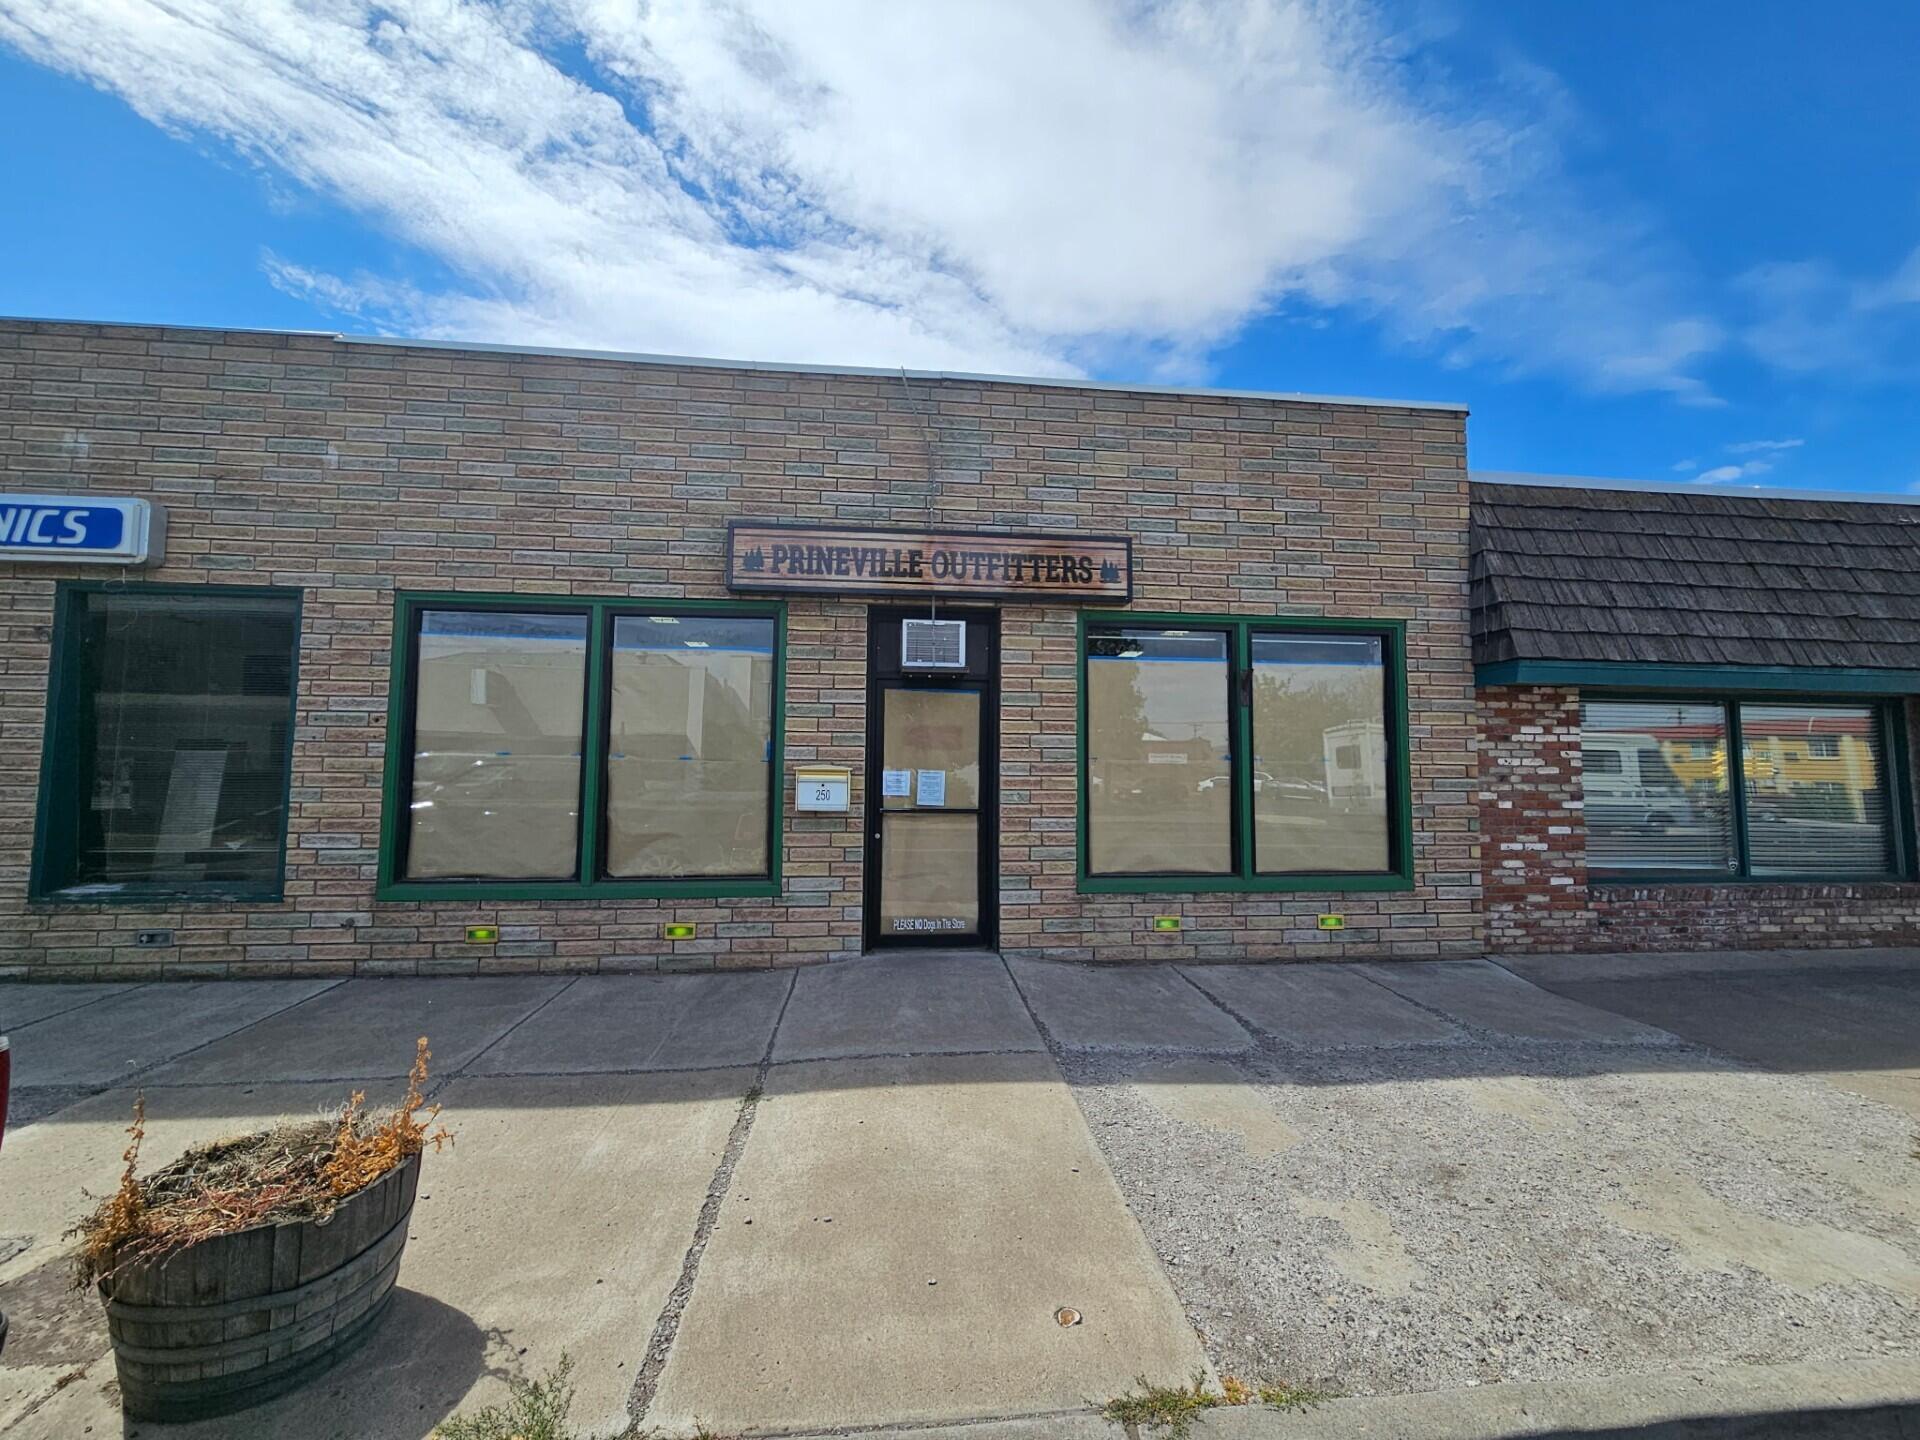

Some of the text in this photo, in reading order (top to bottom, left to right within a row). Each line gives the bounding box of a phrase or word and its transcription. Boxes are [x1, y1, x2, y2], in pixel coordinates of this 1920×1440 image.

[771, 544, 1093, 584] PRINEVILLE OUTFITTERS
[816, 789, 831, 801] 250
[894, 918, 914, 930] PLEASE
[915, 919, 923, 930] NO
[923, 919, 936, 932] Dogs
[942, 918, 951, 929] The
[952, 918, 966, 929] Store
